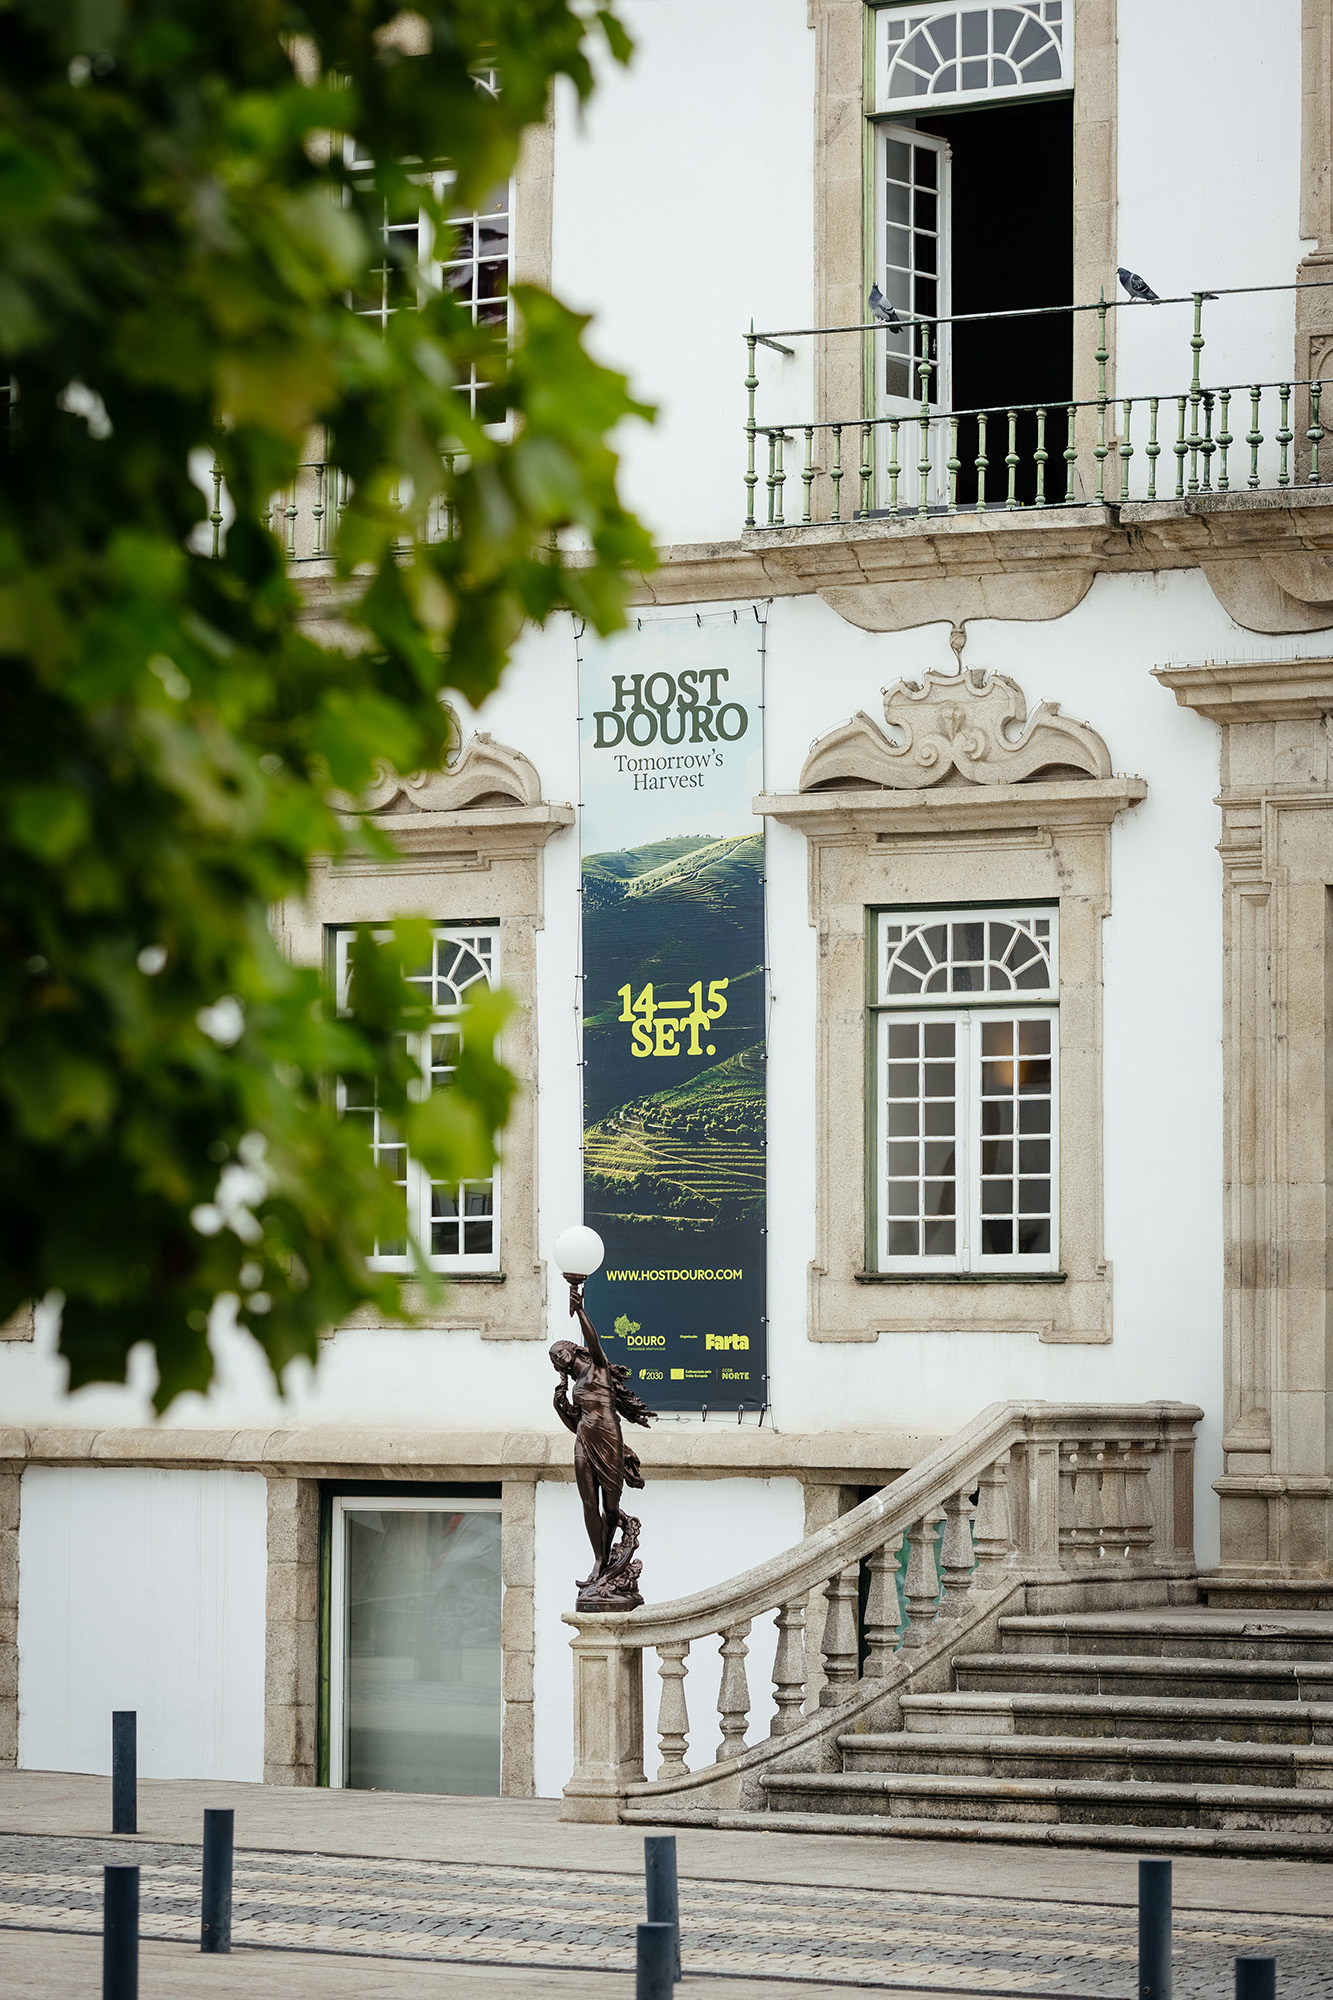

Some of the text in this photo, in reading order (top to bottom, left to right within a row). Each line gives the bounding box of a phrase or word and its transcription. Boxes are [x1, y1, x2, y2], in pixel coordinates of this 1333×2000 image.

[611, 668, 729, 712] HOST
[593, 703, 748, 749] DOURO
[614, 748, 724, 772] Tomorrow's
[633, 772, 705, 791] Harvest
[631, 1017, 717, 1058] SET.
[606, 1268, 743, 1282] WWW.HOSTDOURO.COM
[627, 1335, 666, 1346] DOURO
[705, 1333, 750, 1350] Farta
[646, 1371, 664, 1380] 2030
[721, 1372, 750, 1380] NORTE
